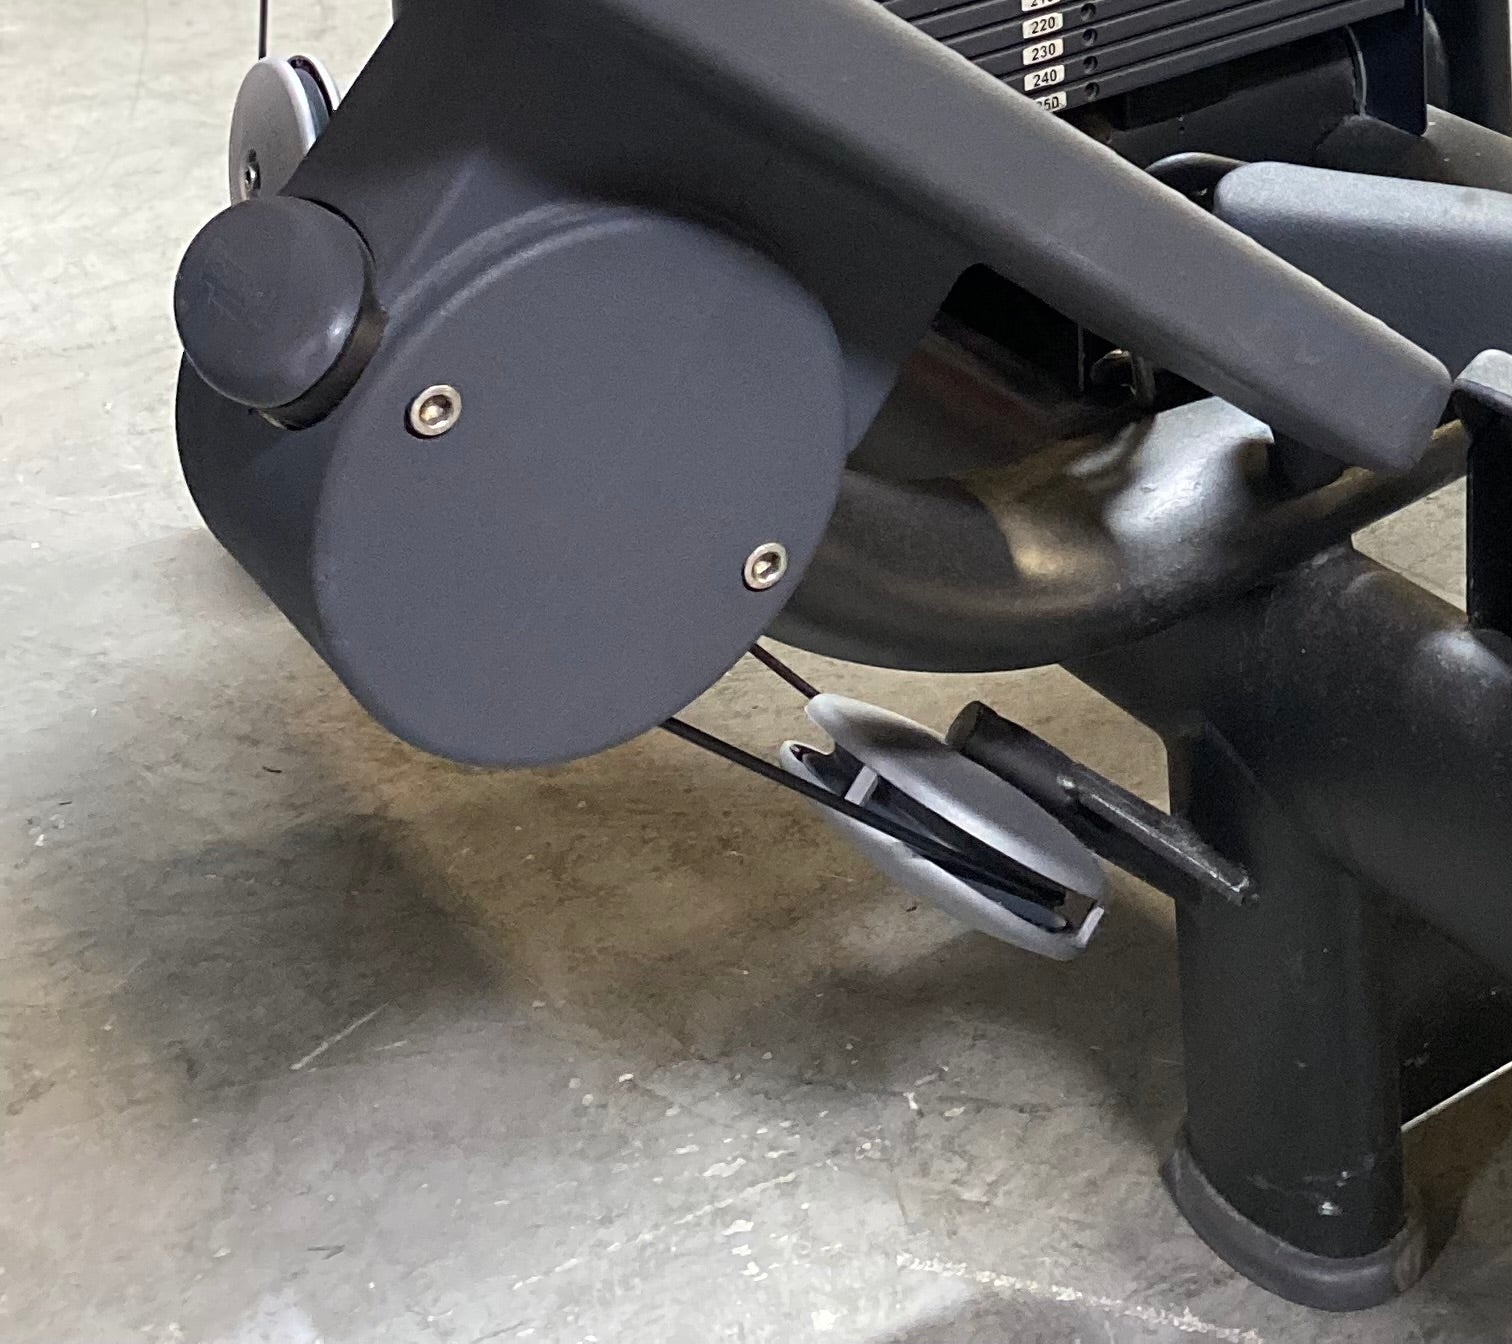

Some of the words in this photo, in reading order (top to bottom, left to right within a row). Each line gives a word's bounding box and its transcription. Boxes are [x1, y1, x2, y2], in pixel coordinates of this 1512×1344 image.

[1031, 16, 1056, 32] 220
[1031, 43, 1056, 60] 230
[1033, 70, 1057, 87] 240
